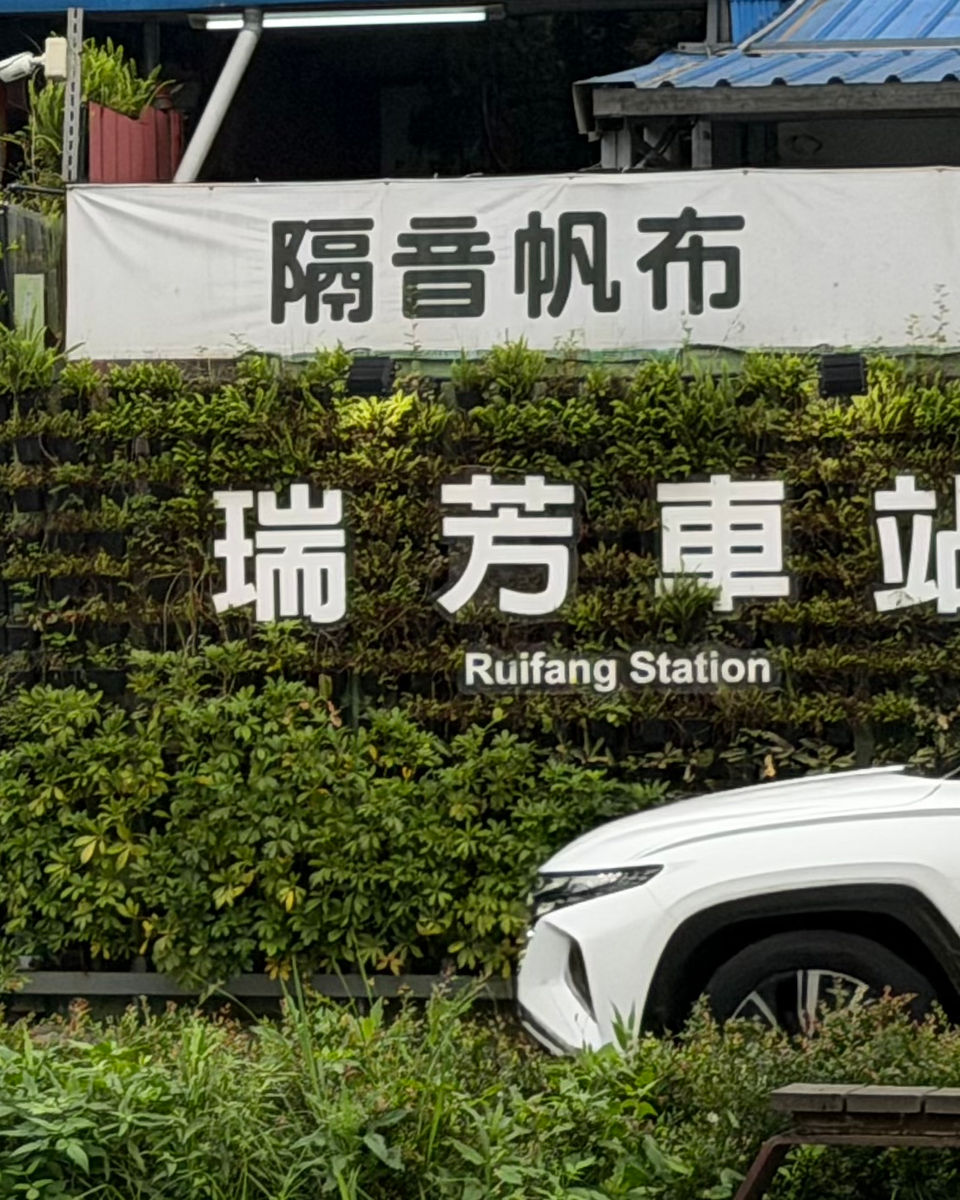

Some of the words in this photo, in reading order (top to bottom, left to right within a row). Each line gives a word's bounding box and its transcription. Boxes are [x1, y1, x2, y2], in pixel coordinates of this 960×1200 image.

[270, 206, 746, 325] 隔音帆布
[211, 473, 960, 625] 瑞芳車站
[465, 652, 618, 693] Ruifang
[629, 651, 771, 684] Station
